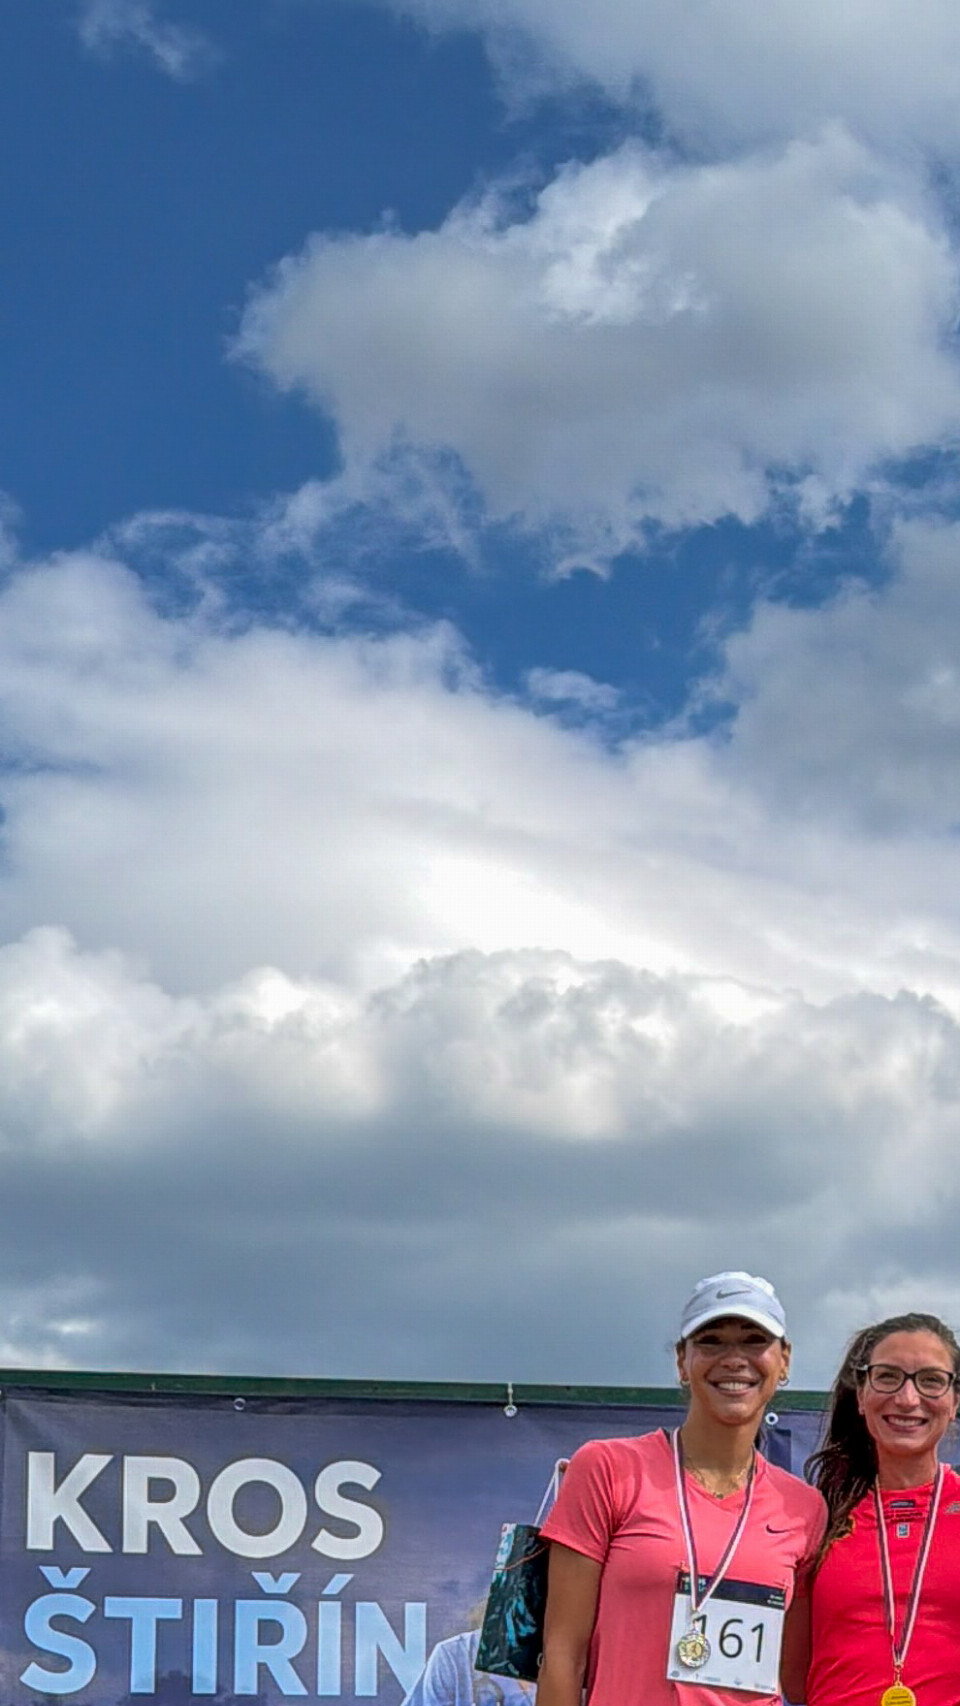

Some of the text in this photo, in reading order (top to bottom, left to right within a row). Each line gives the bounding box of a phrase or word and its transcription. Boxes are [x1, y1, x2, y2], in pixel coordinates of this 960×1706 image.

[26, 1451, 384, 1560] KROS
[19, 1565, 427, 1697] ŠTIŘÍN
[693, 1614, 764, 1663] 161
